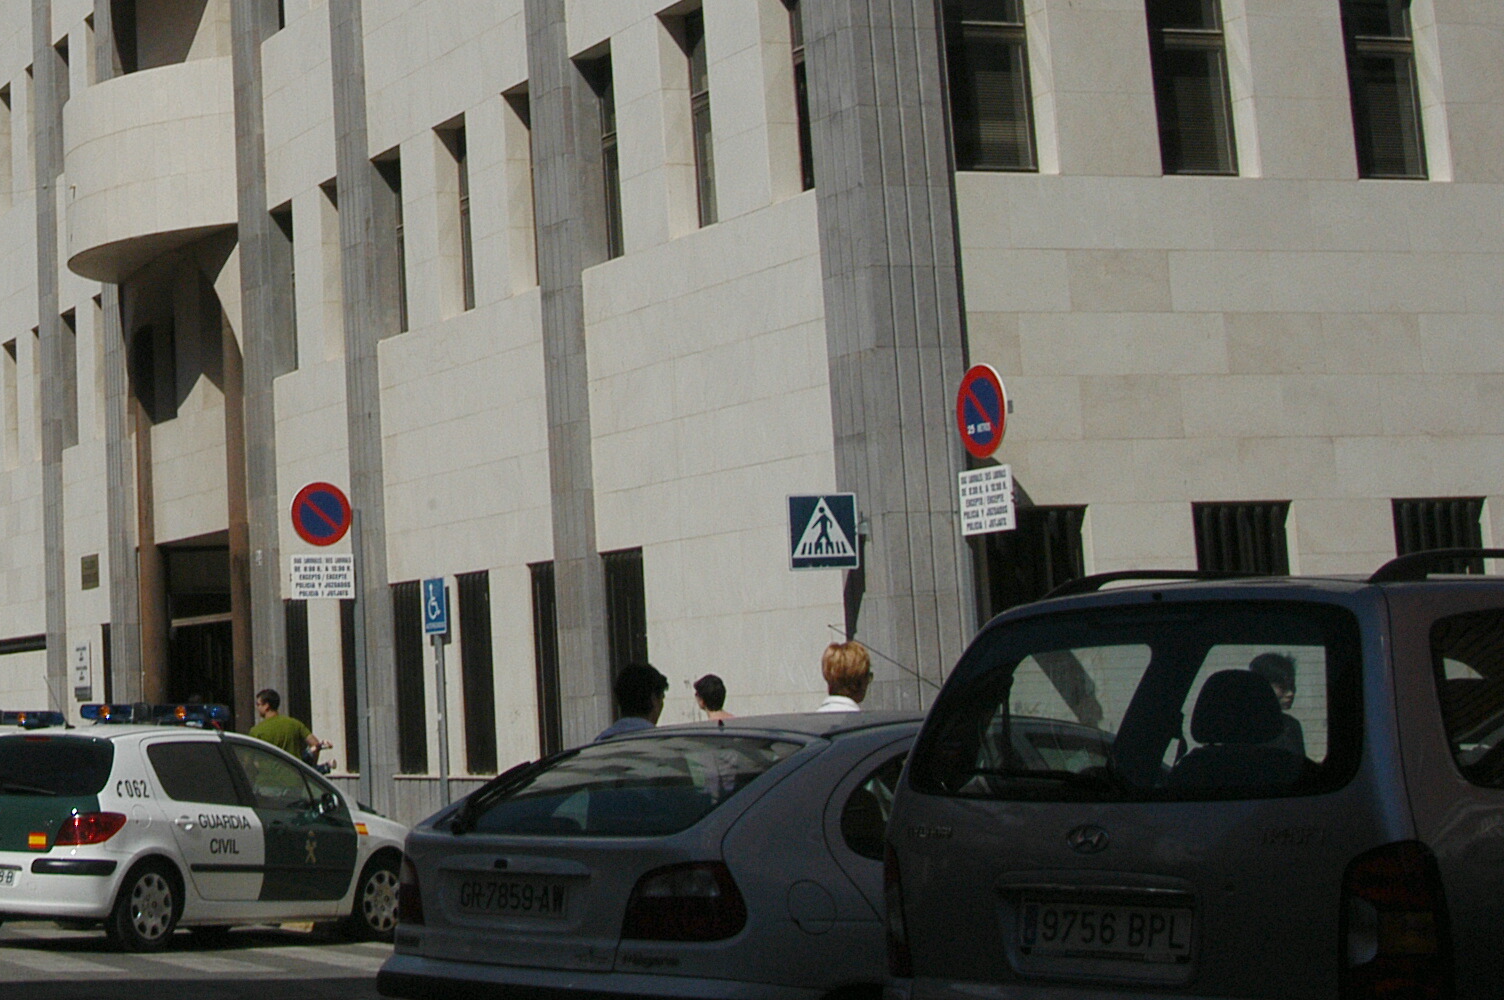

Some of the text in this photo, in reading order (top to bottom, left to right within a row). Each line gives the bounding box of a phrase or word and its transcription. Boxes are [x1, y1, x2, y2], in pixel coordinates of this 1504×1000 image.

[967, 423, 975, 435] 25
[125, 780, 151, 798] 062
[198, 814, 252, 829] GUARDIA
[209, 838, 240, 855] CIVIL
[1041, 910, 1185, 950] 9756 BPL
